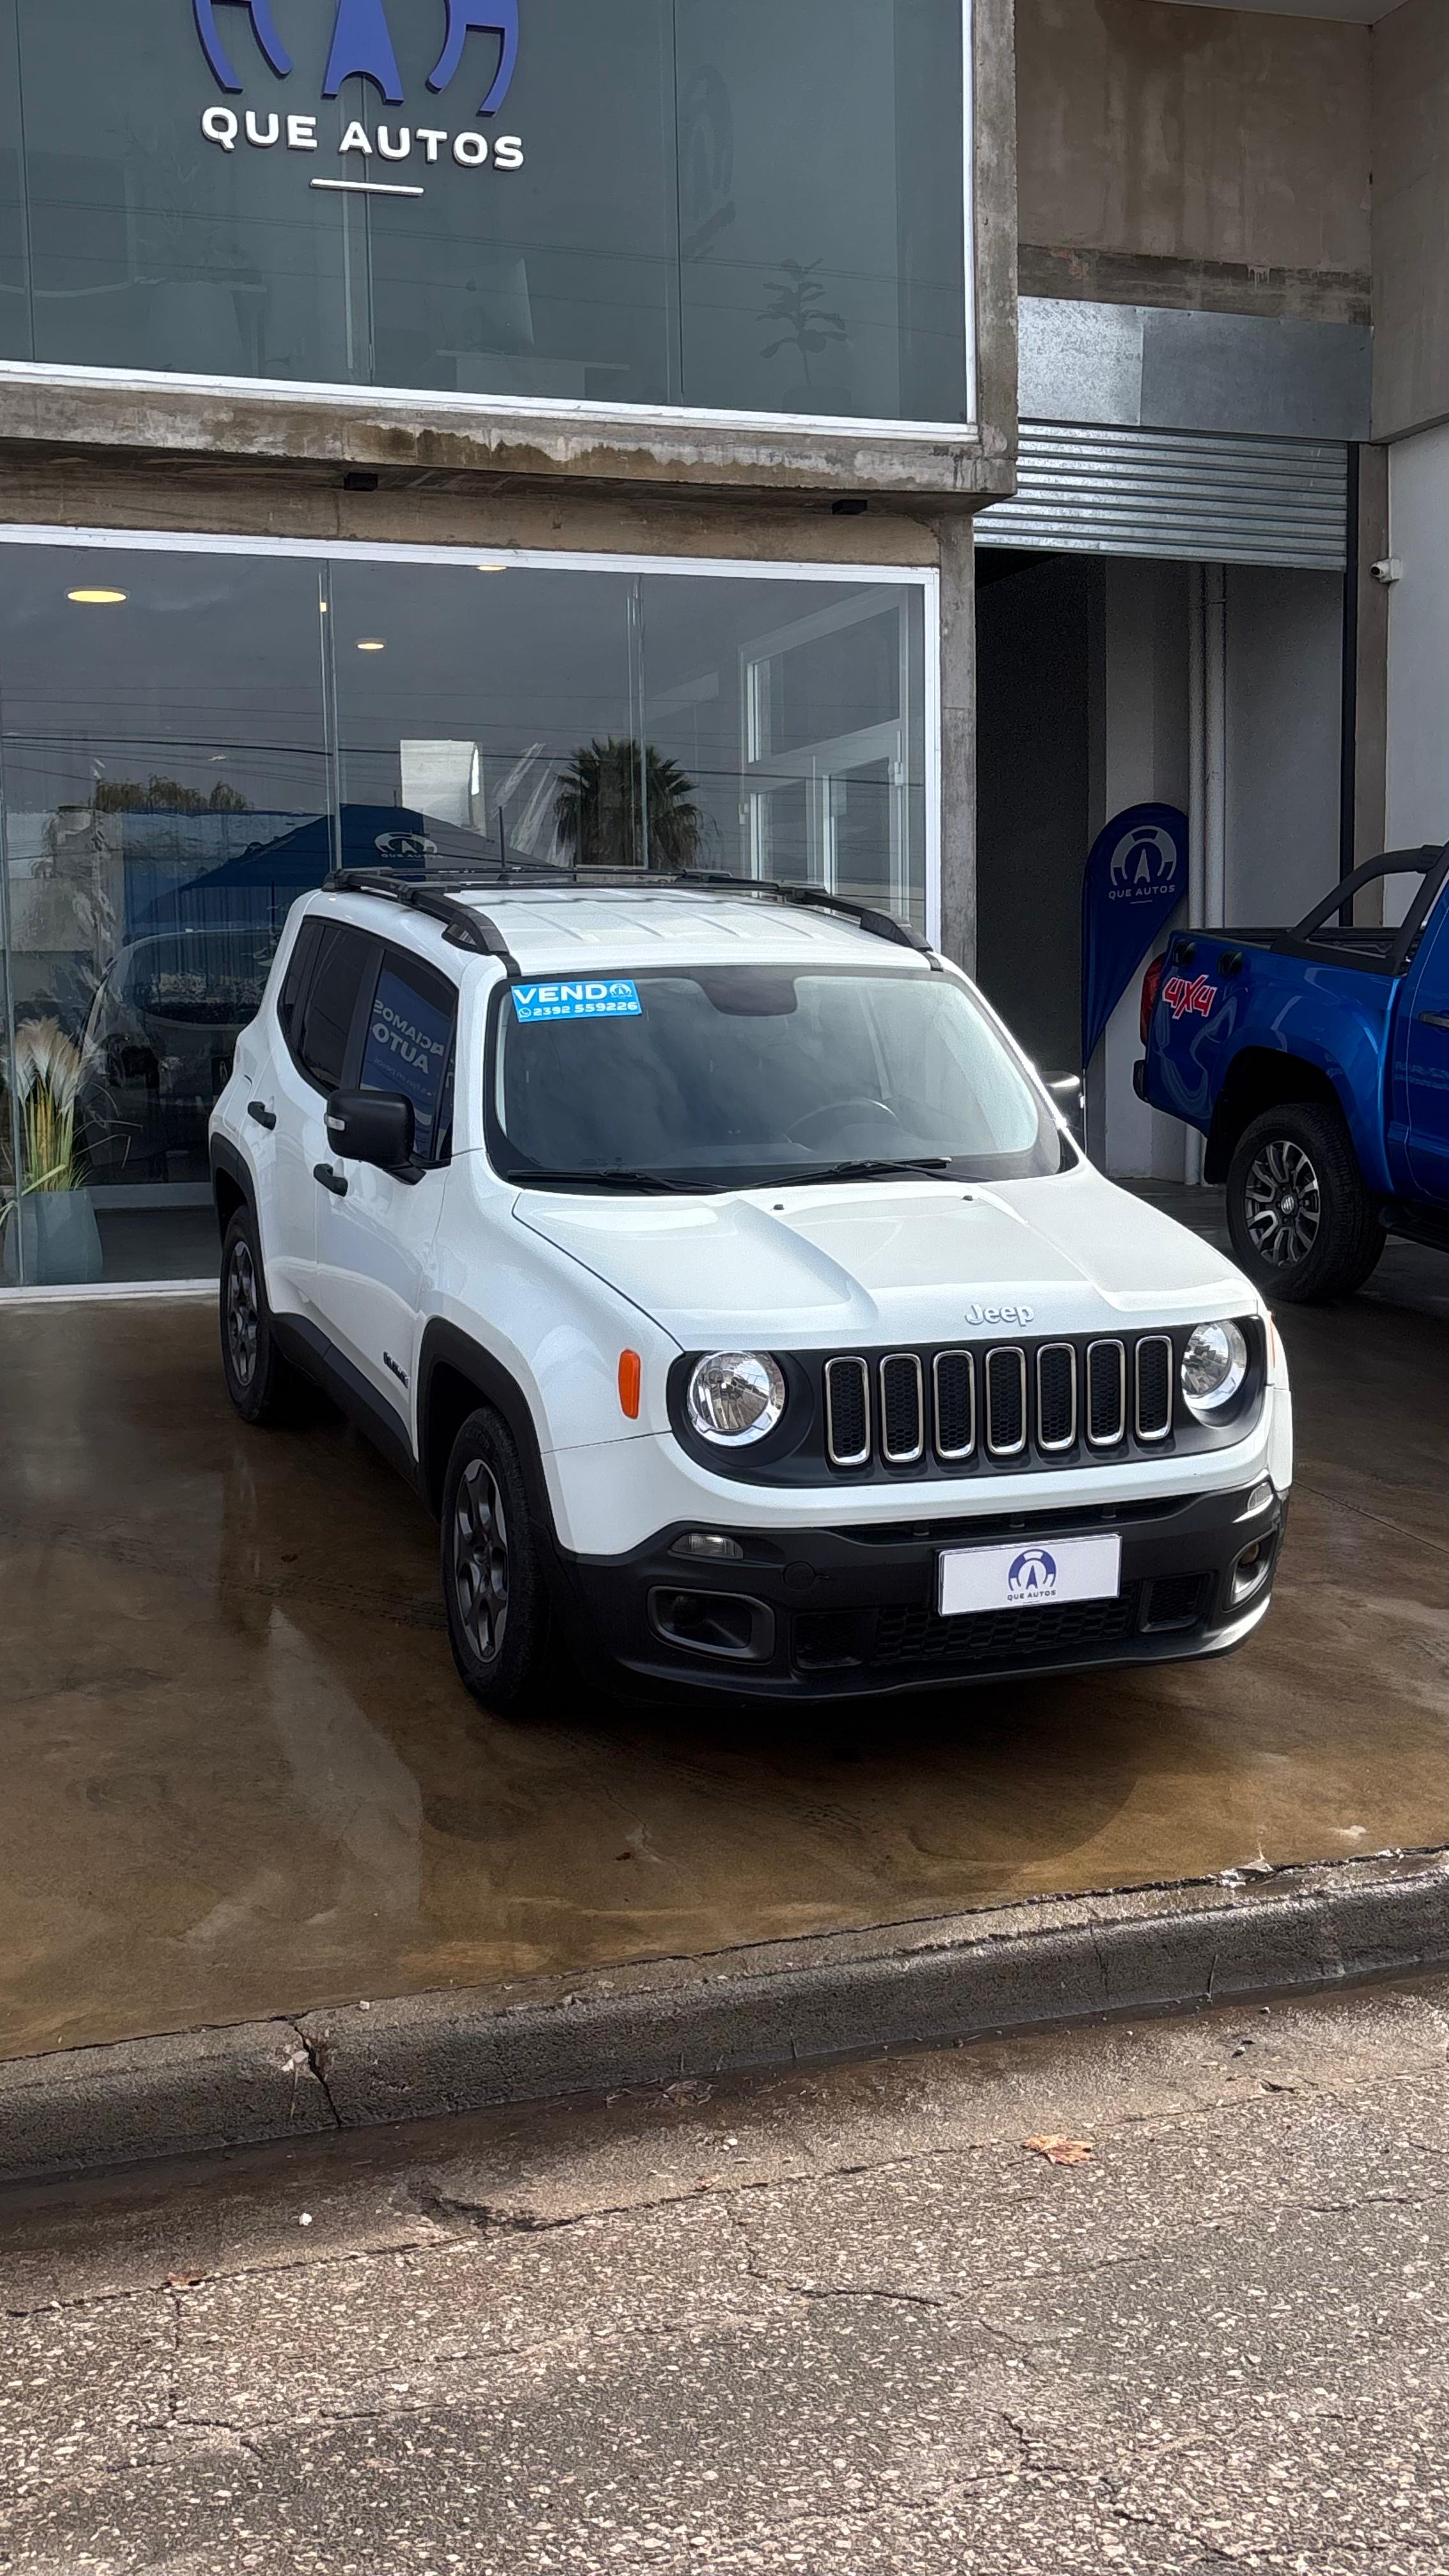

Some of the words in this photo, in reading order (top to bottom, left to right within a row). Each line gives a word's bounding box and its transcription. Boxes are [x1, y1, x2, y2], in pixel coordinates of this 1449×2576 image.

[201, 107, 318, 152] QUE
[339, 121, 525, 171] AUTOS
[1108, 889, 1132, 900] QUE
[1135, 885, 1176, 896] AUTOS
[533, 1006, 571, 1016] 2392
[574, 1002, 638, 1013] 559226
[964, 1303, 1035, 1327] Jeep
[1007, 1593, 1025, 1602] QUE
[1027, 1590, 1056, 1598] AUTOS
